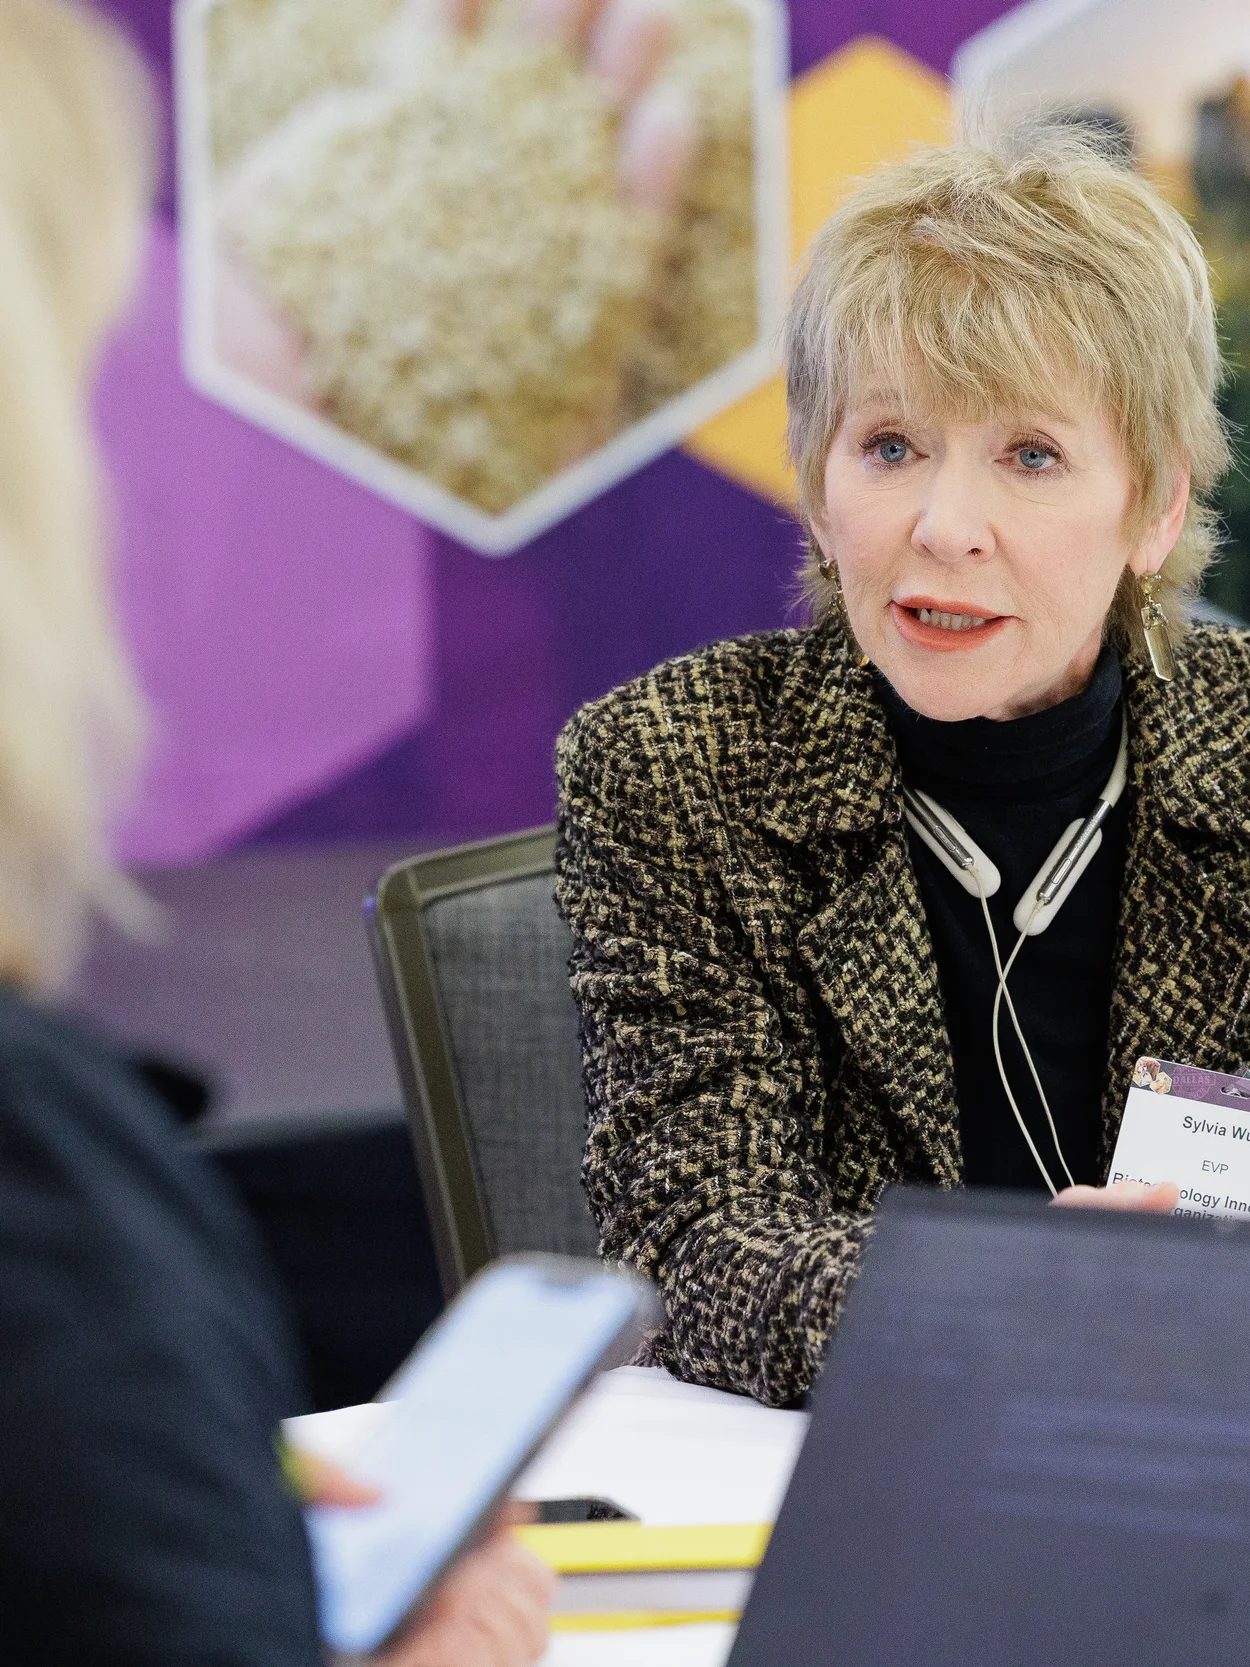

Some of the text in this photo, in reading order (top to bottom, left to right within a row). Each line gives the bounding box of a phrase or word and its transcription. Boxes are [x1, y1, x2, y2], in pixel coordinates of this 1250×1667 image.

[1172, 1075, 1211, 1085] DALLAS
[1182, 1115, 1227, 1136] Sylvia
[1201, 1159, 1229, 1174] EVP
